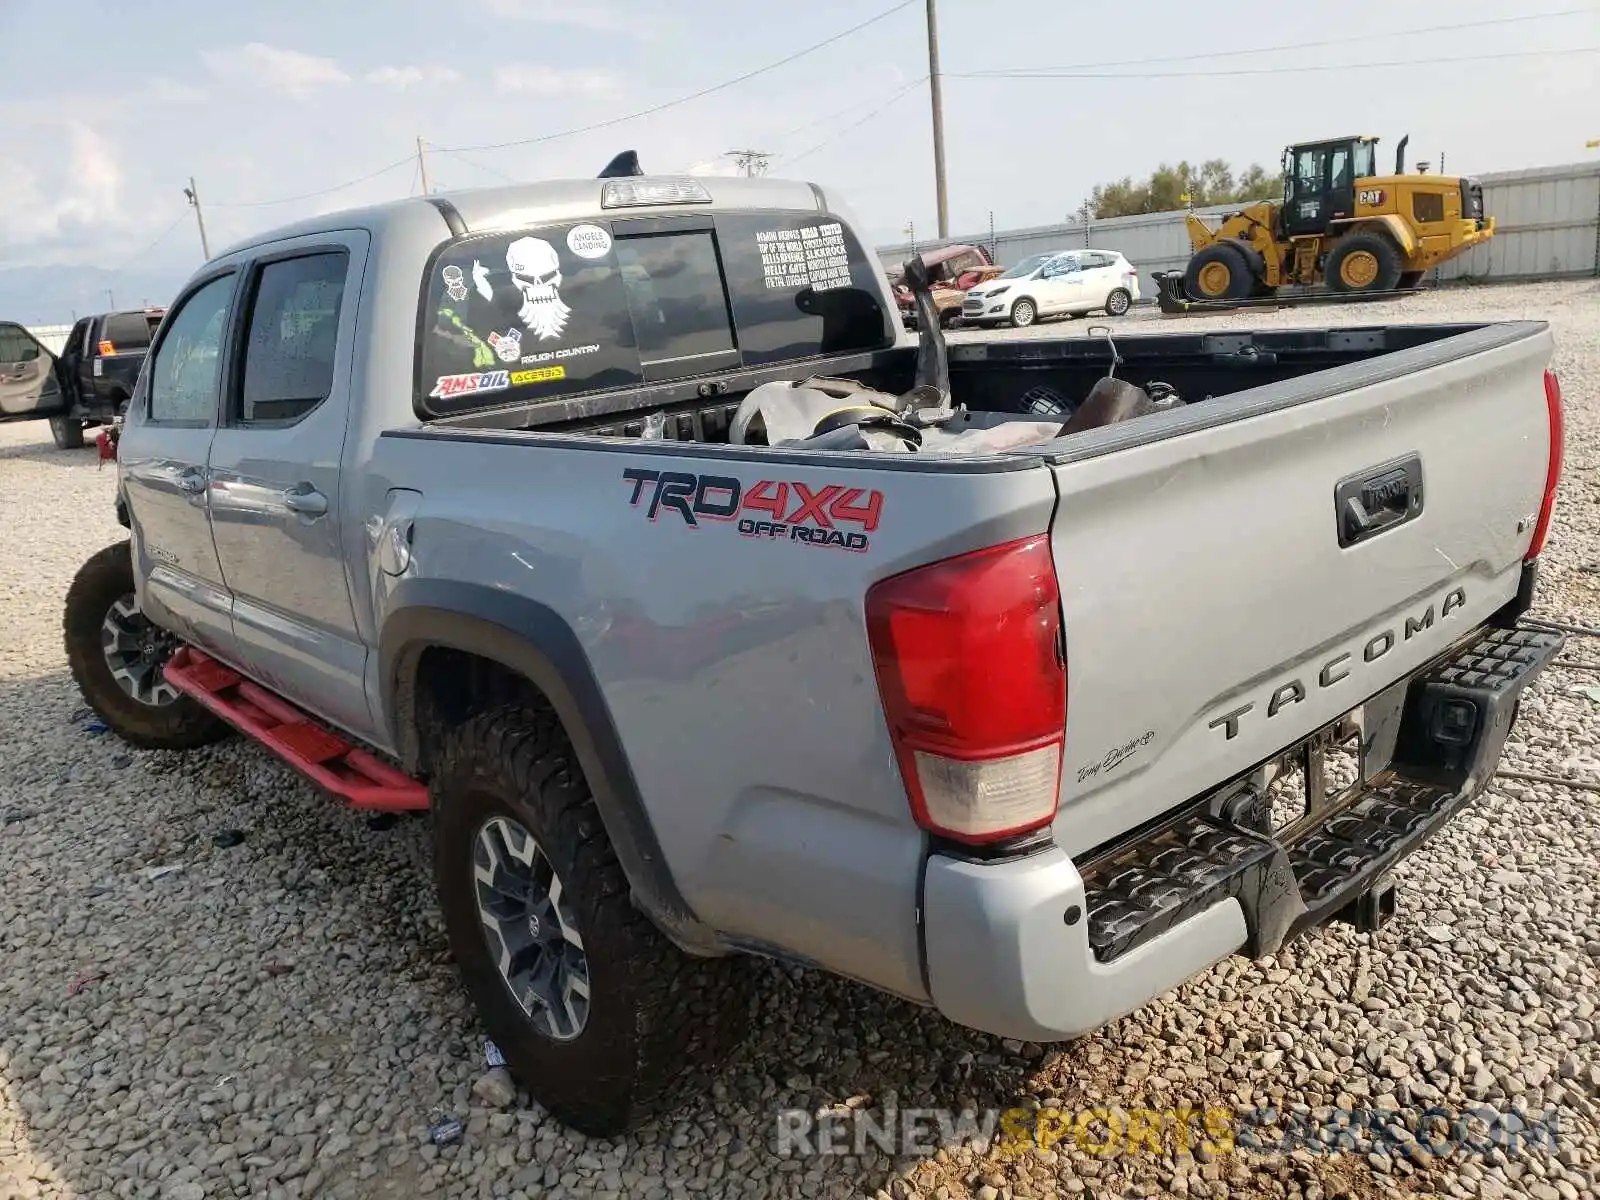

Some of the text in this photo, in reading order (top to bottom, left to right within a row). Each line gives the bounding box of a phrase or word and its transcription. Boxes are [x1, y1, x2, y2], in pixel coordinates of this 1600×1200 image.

[1359, 189, 1382, 205] CAT
[574, 241, 609, 251] LANDING
[763, 262, 807, 276] HELLS GATE
[521, 345, 600, 365] ROUGH COUNTRY
[433, 371, 508, 398] AMSOIL
[623, 468, 884, 532] TRD 4X4
[736, 519, 870, 553] OFF ROAD
[1208, 586, 1467, 741] TACOMA
